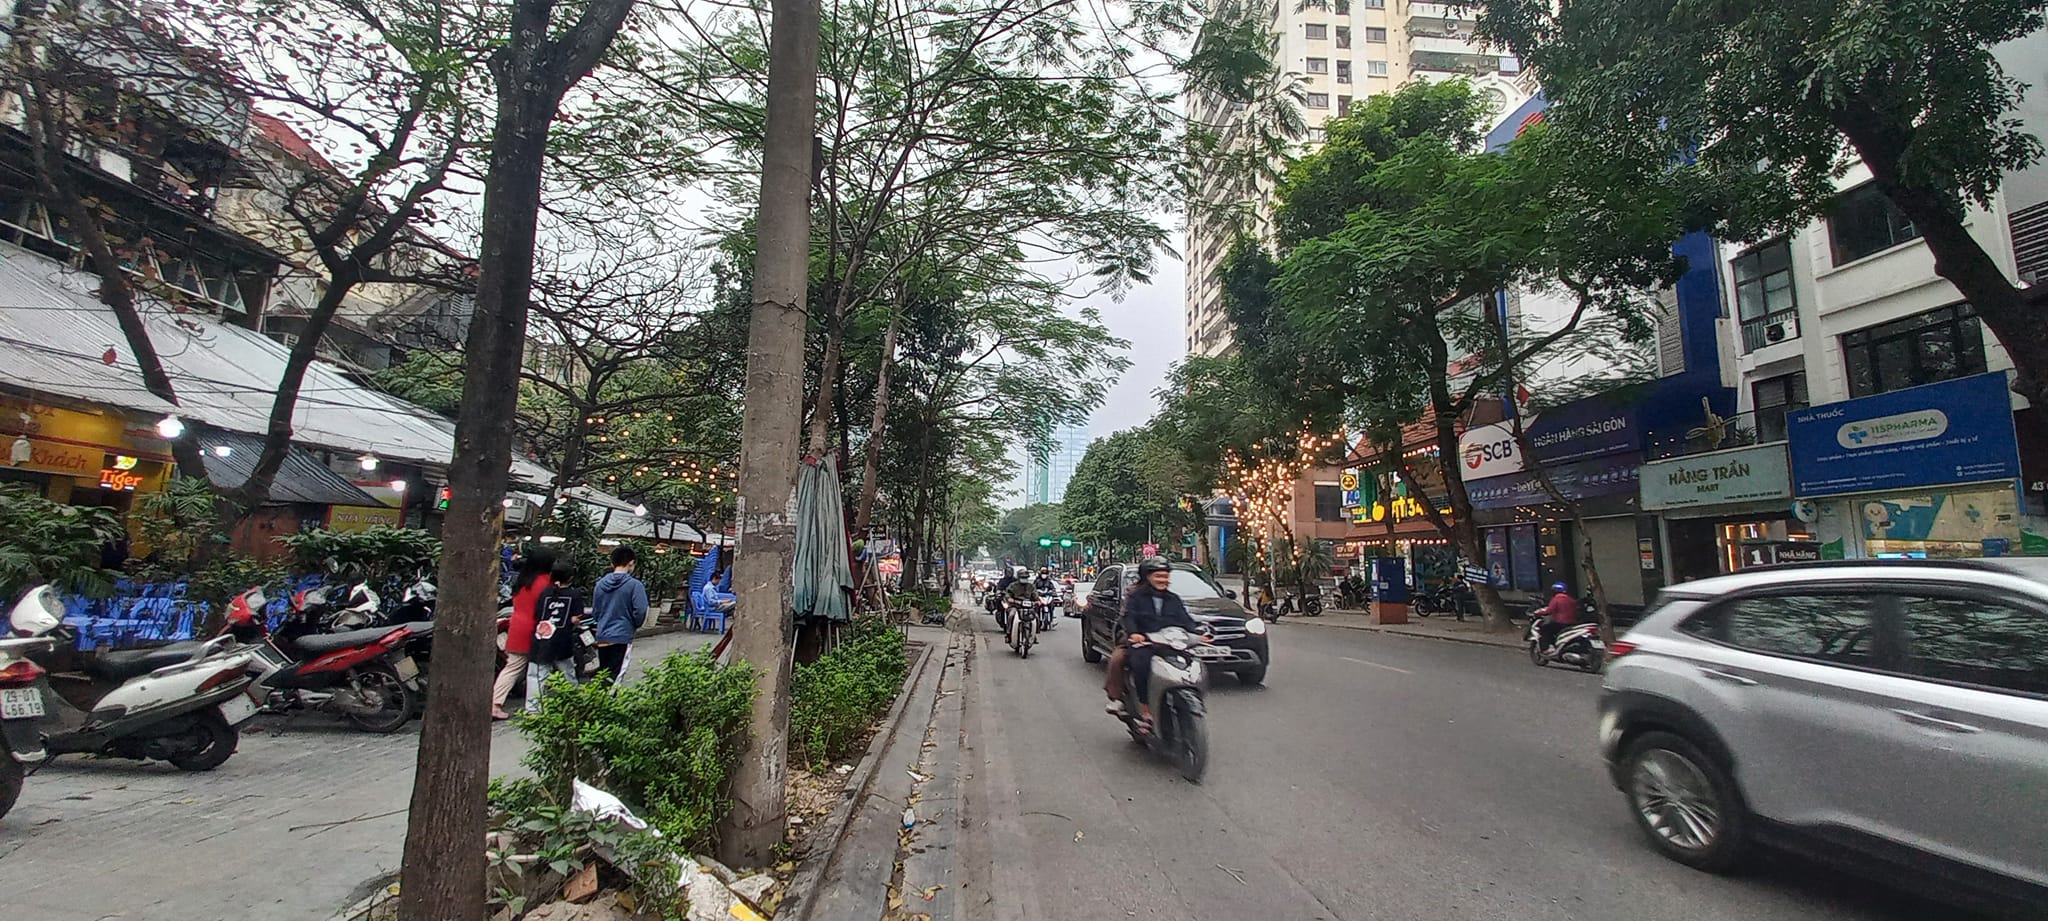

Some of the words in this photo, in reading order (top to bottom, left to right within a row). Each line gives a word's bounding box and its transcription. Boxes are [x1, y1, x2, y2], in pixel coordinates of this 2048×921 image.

[1797, 414, 1815, 423] NHÀ
[1816, 408, 1846, 419] THUỐC
[1602, 416, 1627, 433] GÒN
[1483, 440, 1513, 462] SCB
[101, 469, 143, 490] Tiger
[2031, 481, 2044, 491] 43
[1697, 483, 1719, 493] MART
[1751, 549, 1763, 565] 1
